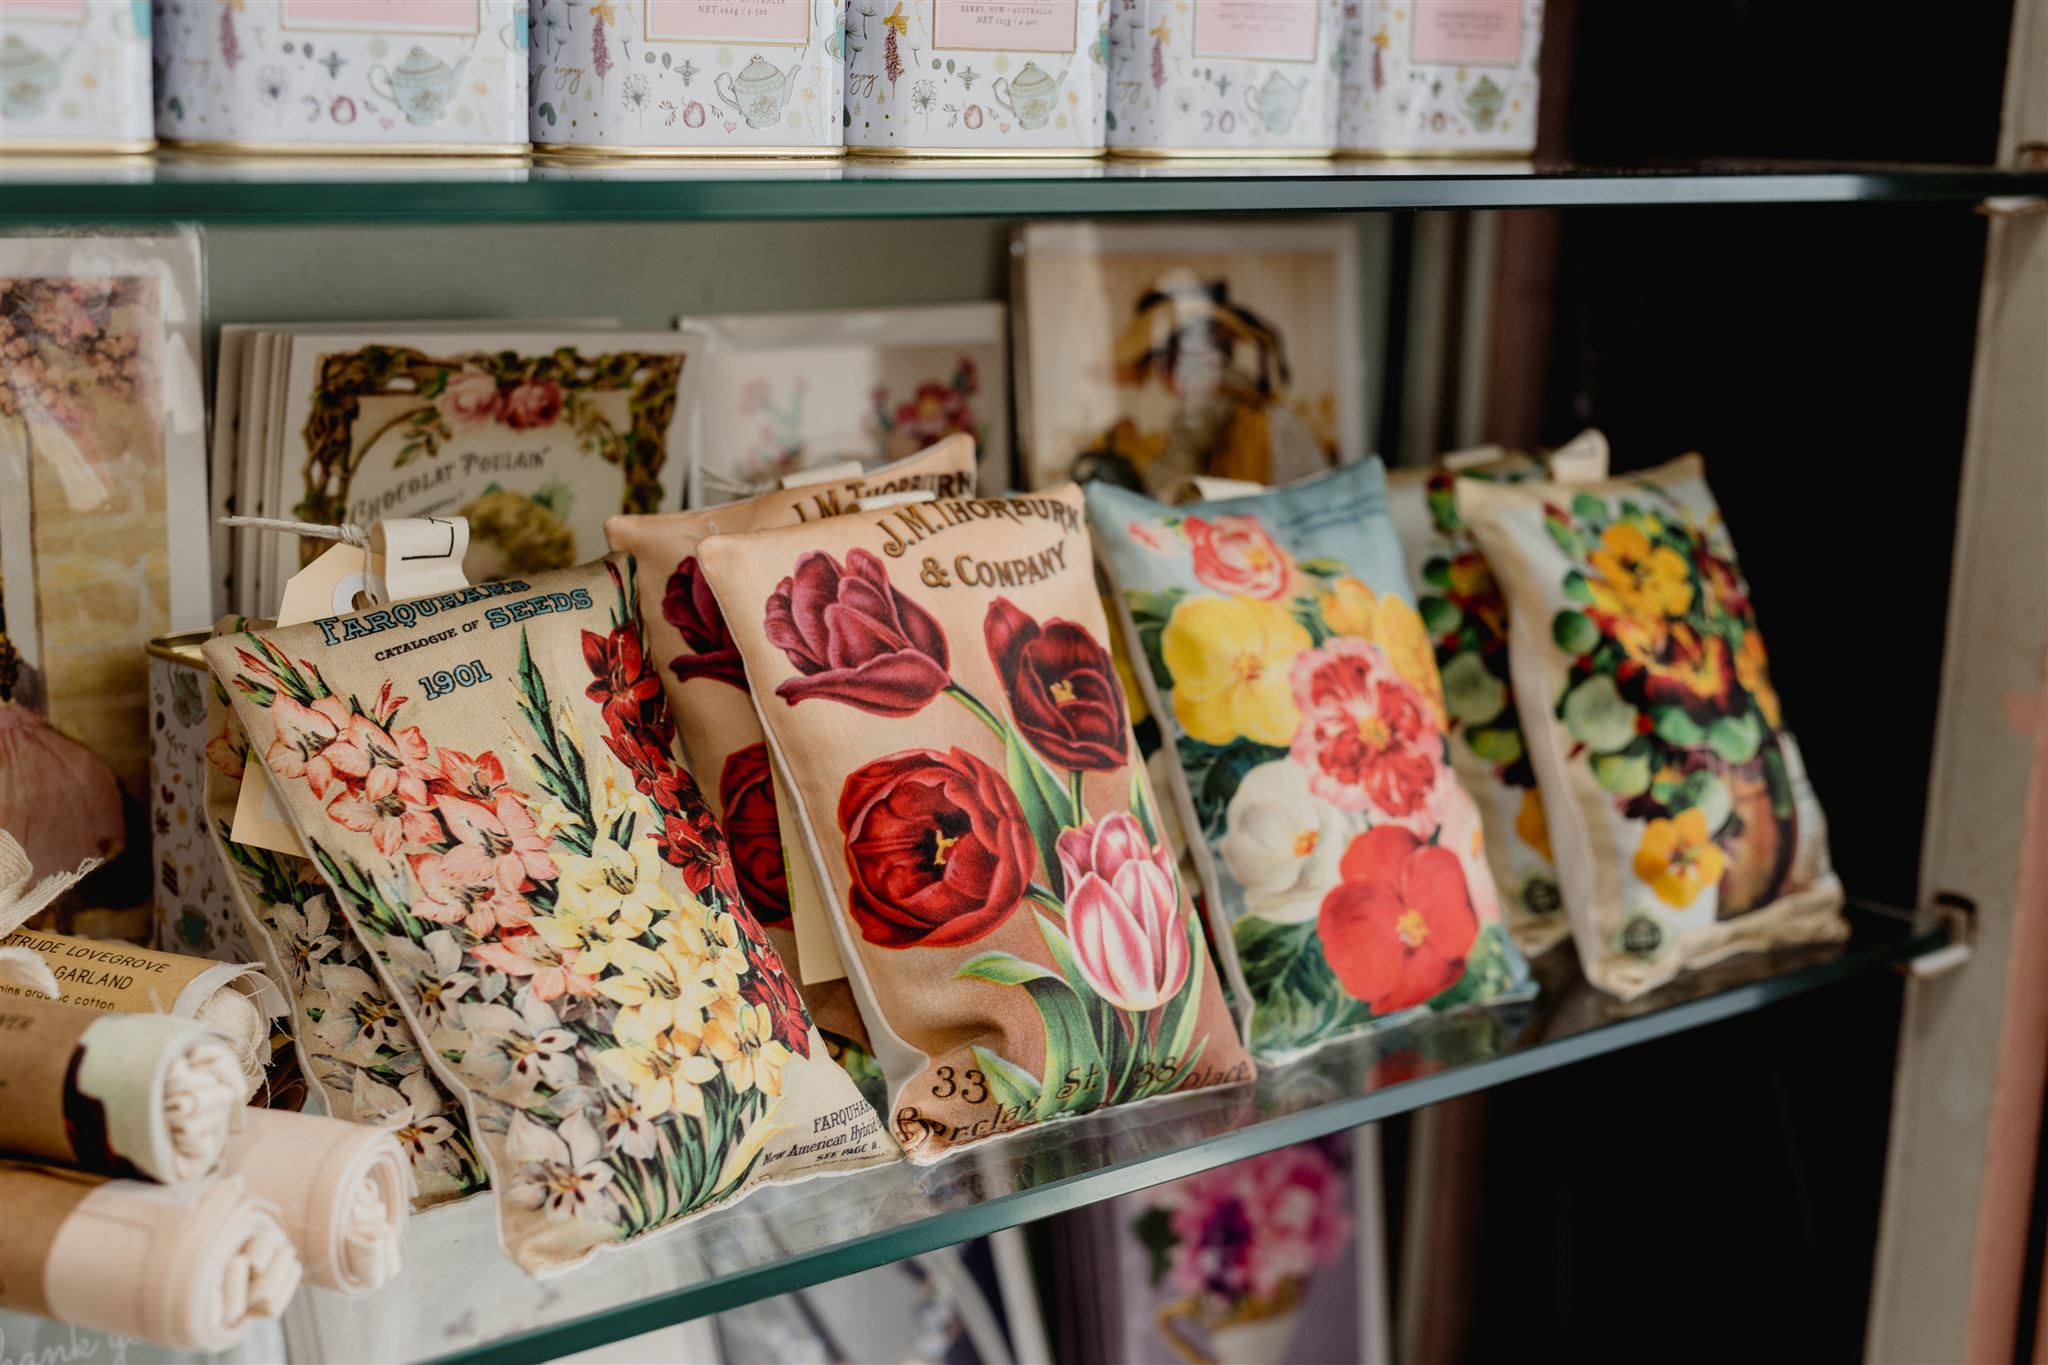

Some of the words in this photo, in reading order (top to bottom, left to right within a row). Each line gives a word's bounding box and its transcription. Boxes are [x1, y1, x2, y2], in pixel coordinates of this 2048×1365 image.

[697, 5, 717, 15] NET
[976, 16, 995, 25] NET
[1012, 7, 1053, 16] AUSTRALIA
[849, 71, 879, 99] enjoy
[920, 556, 951, 588] &
[954, 540, 1068, 588] COMPANY
[315, 579, 532, 647] FARQUHARS
[374, 627, 459, 662] CATALOGUE
[462, 619, 481, 640] OF
[484, 588, 594, 630] SEEDS
[418, 659, 493, 701] 1901
[66, 945, 170, 974] LOVEGROVE
[53, 965, 134, 990] GARLAND
[74, 995, 116, 1011] cotton
[931, 1065, 990, 1104] 33
[1055, 1066, 1100, 1100] St.
[1133, 1055, 1177, 1089] 38
[762, 1150, 787, 1167] New
[786, 1133, 847, 1158] American
[815, 1150, 838, 1163] SEE
[840, 1142, 869, 1156] PAGE
